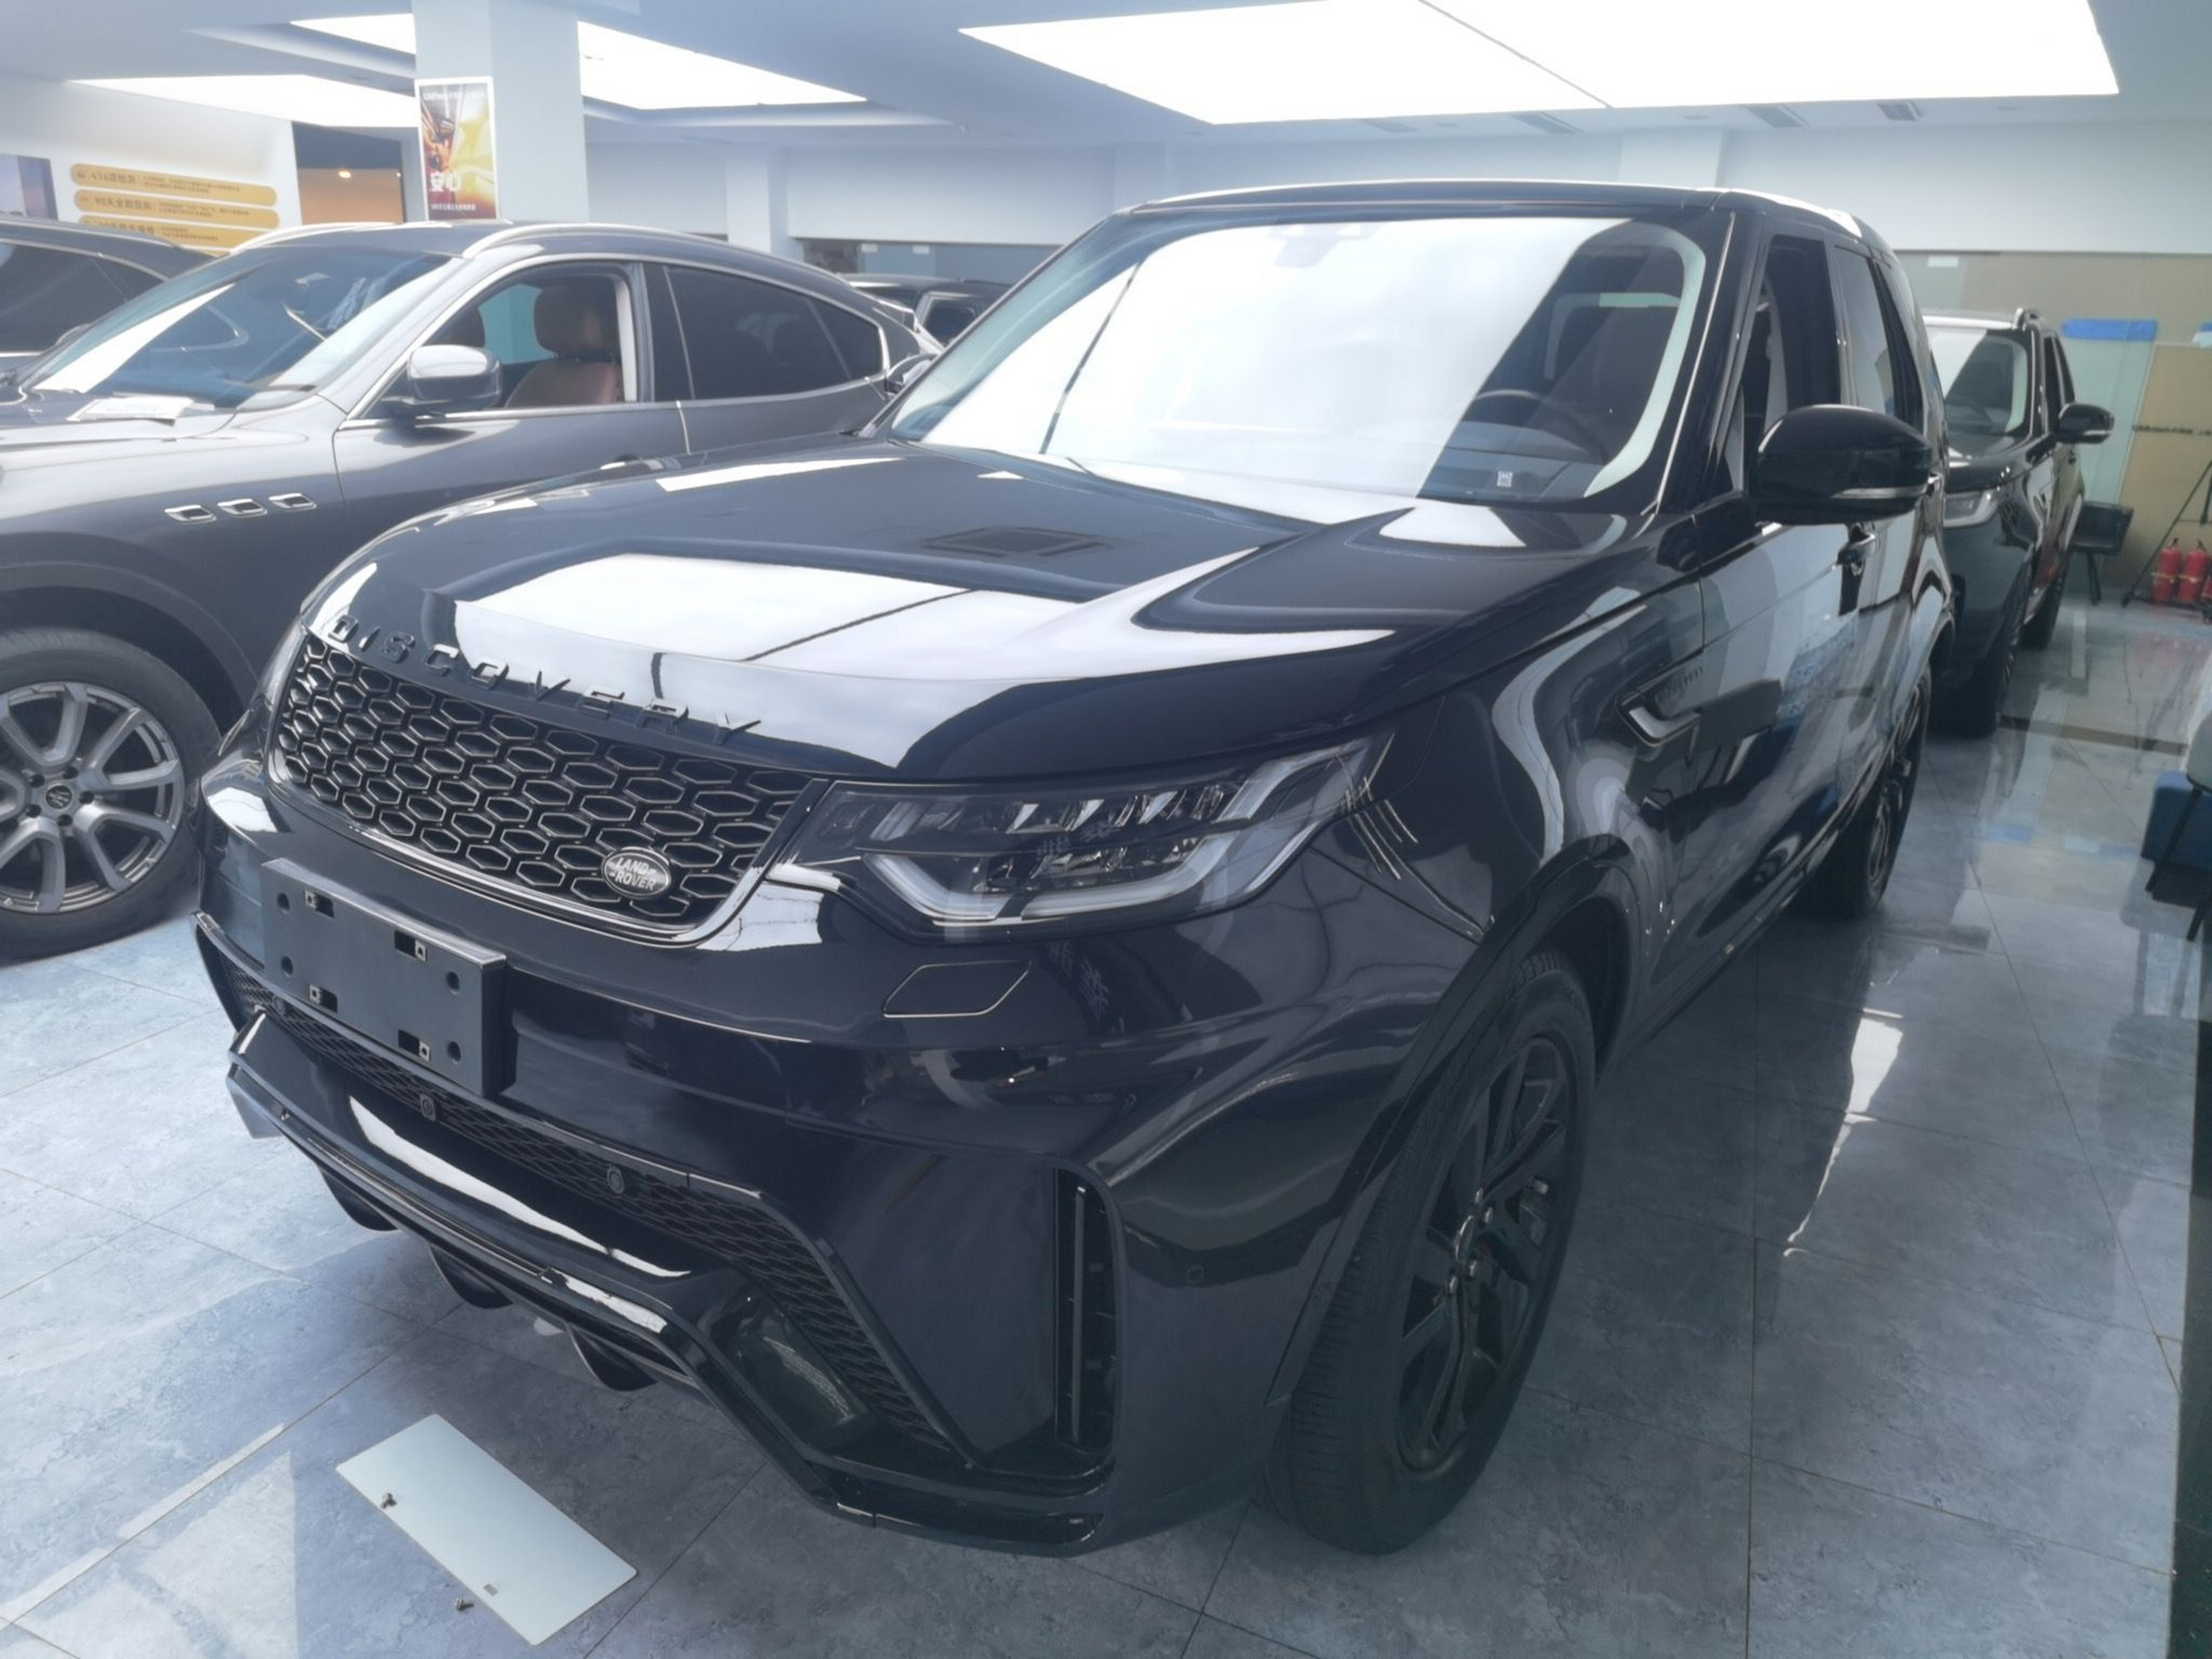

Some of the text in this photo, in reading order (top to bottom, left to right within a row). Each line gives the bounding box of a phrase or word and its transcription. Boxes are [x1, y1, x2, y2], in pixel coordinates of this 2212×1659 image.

[328, 613, 762, 744] DISCOVERY
[615, 857, 650, 874] LAND
[614, 872, 657, 891] ROVER
